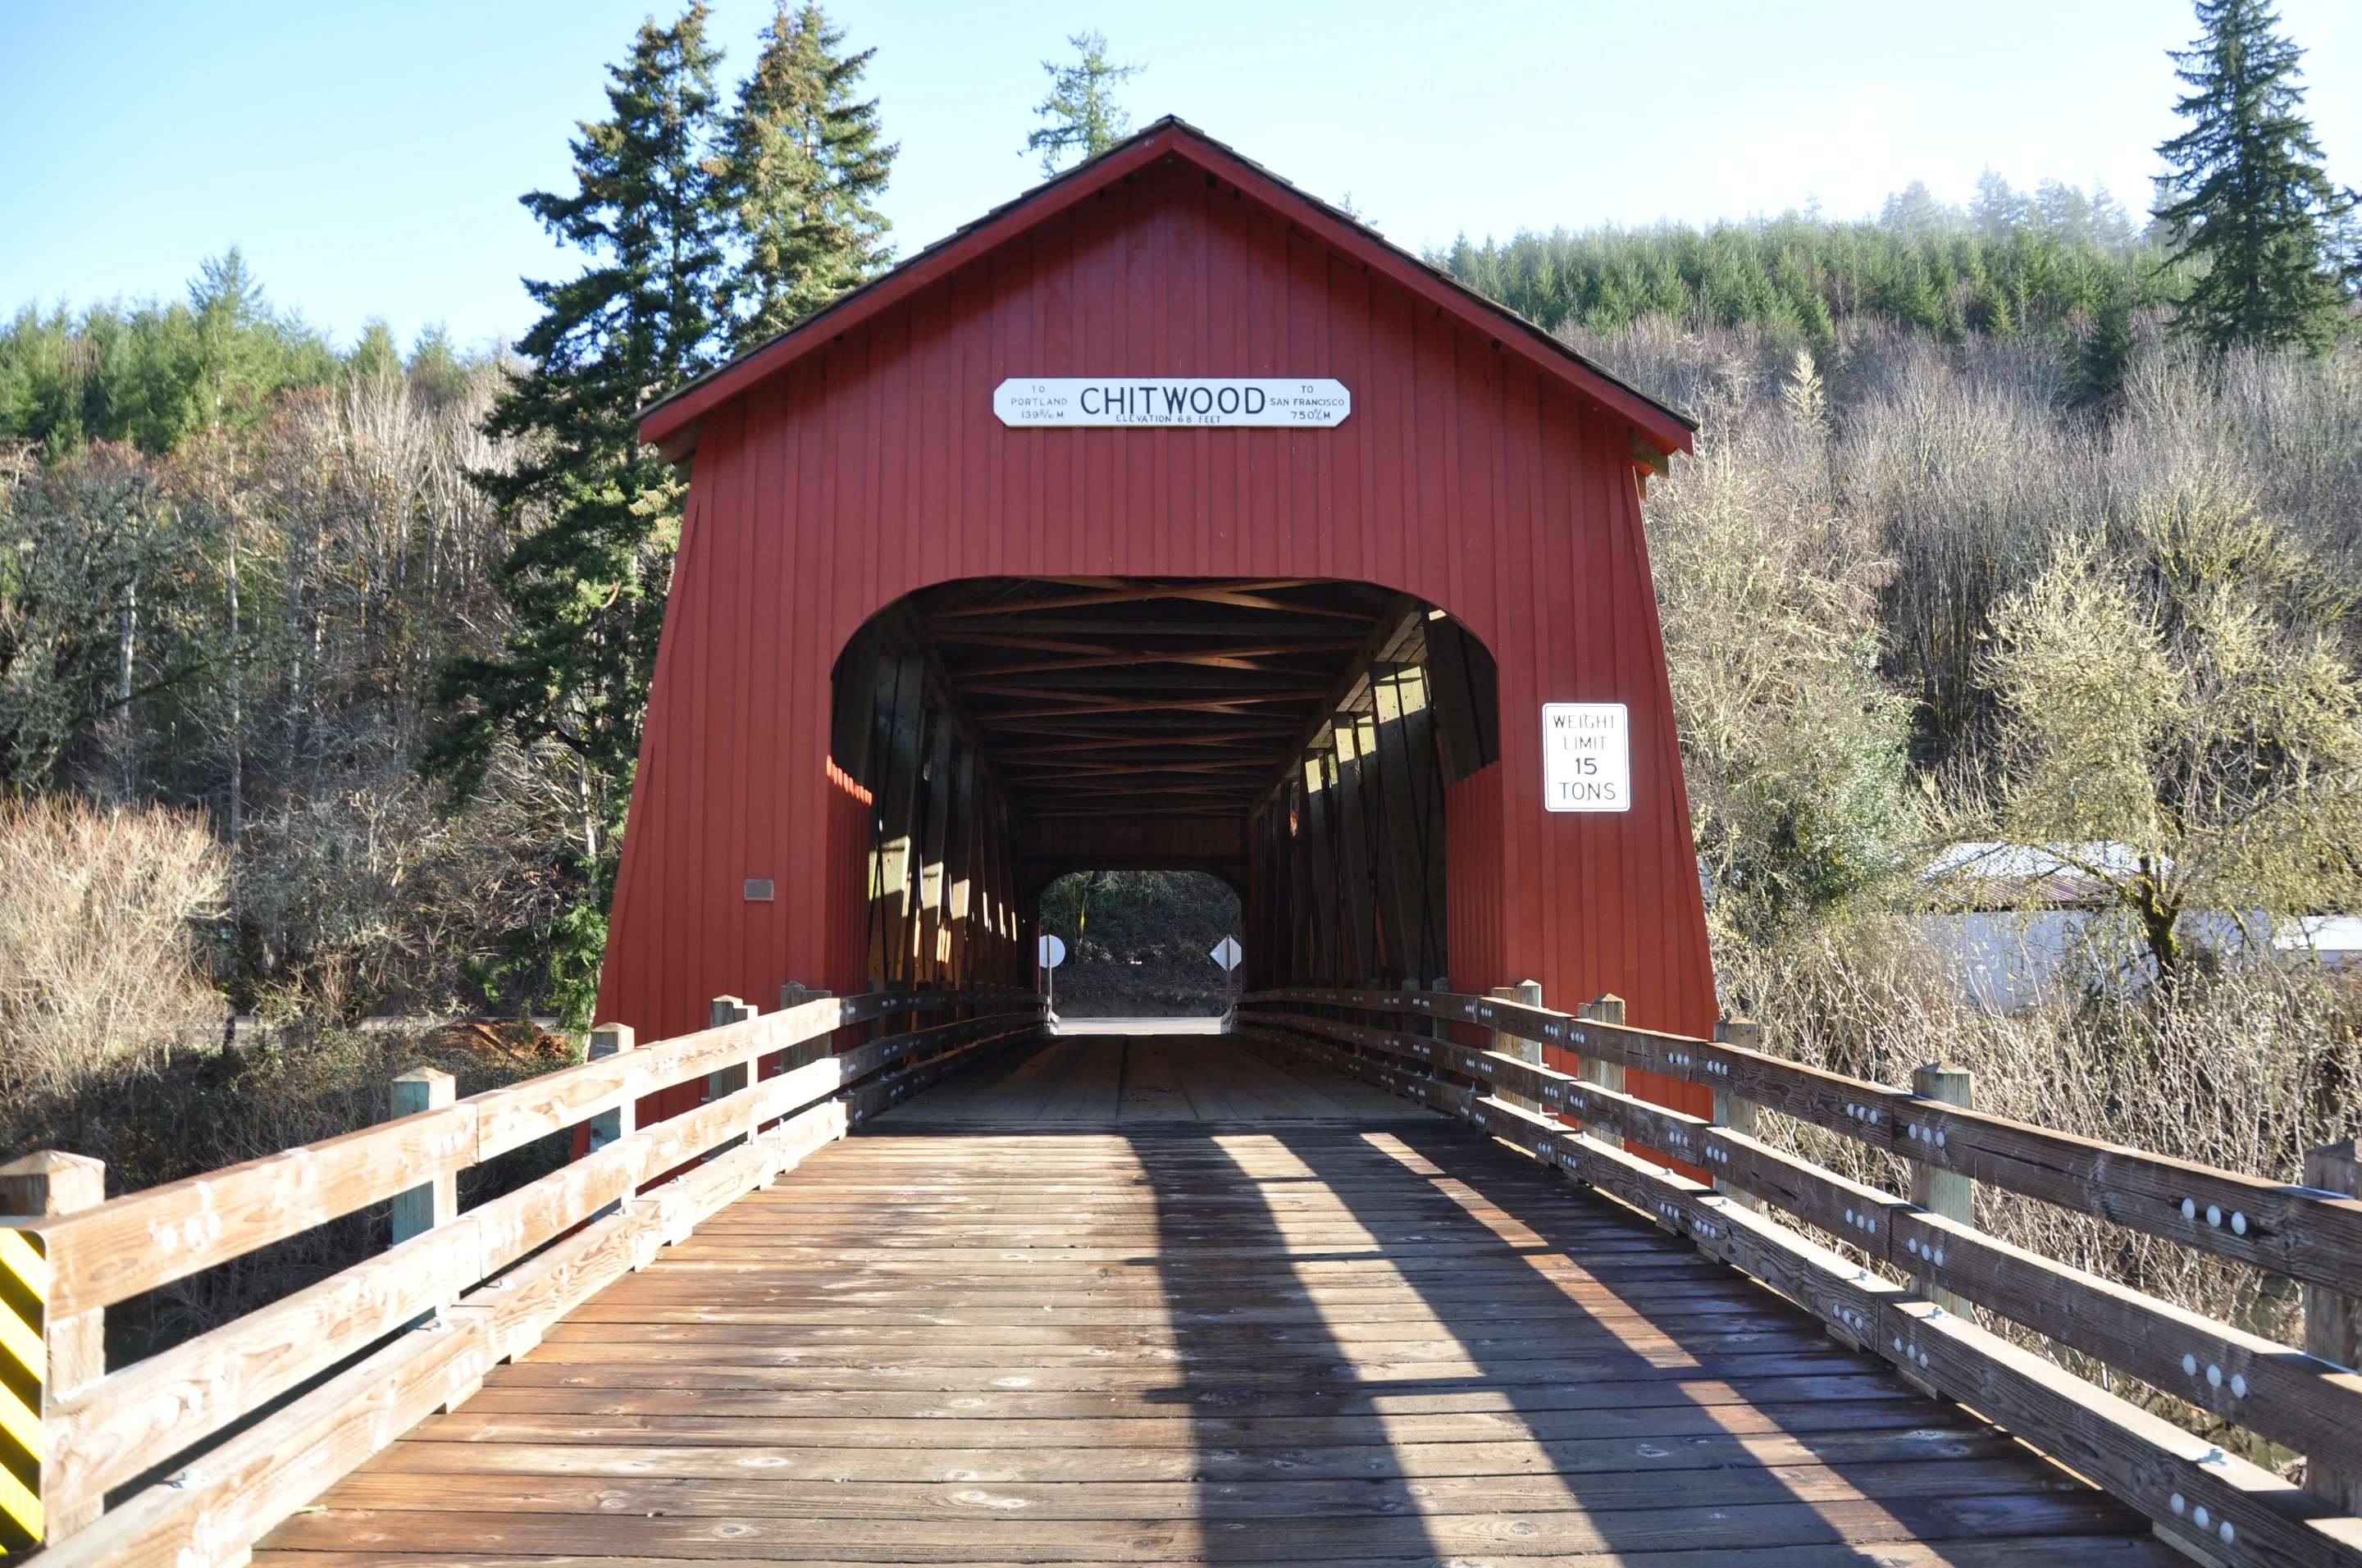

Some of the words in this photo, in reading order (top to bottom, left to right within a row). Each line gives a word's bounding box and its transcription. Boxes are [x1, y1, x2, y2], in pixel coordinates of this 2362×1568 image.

[1301, 385, 1313, 394] TO
[1011, 398, 1068, 406] PORTLAND
[1080, 386, 1265, 415] CHITWOOD
[1270, 398, 1289, 406] SAN
[1293, 398, 1345, 406] FRANCISCO
[1116, 414, 1172, 423] ELEVATION
[1177, 415, 1192, 423] 68
[1198, 415, 1221, 423] FEET
[1324, 411, 1330, 419] M
[1553, 714, 1616, 729] WEIGHT
[1564, 736, 1607, 750] LIMIT
[1575, 757, 1598, 775] 15
[1559, 782, 1616, 801] TONS
